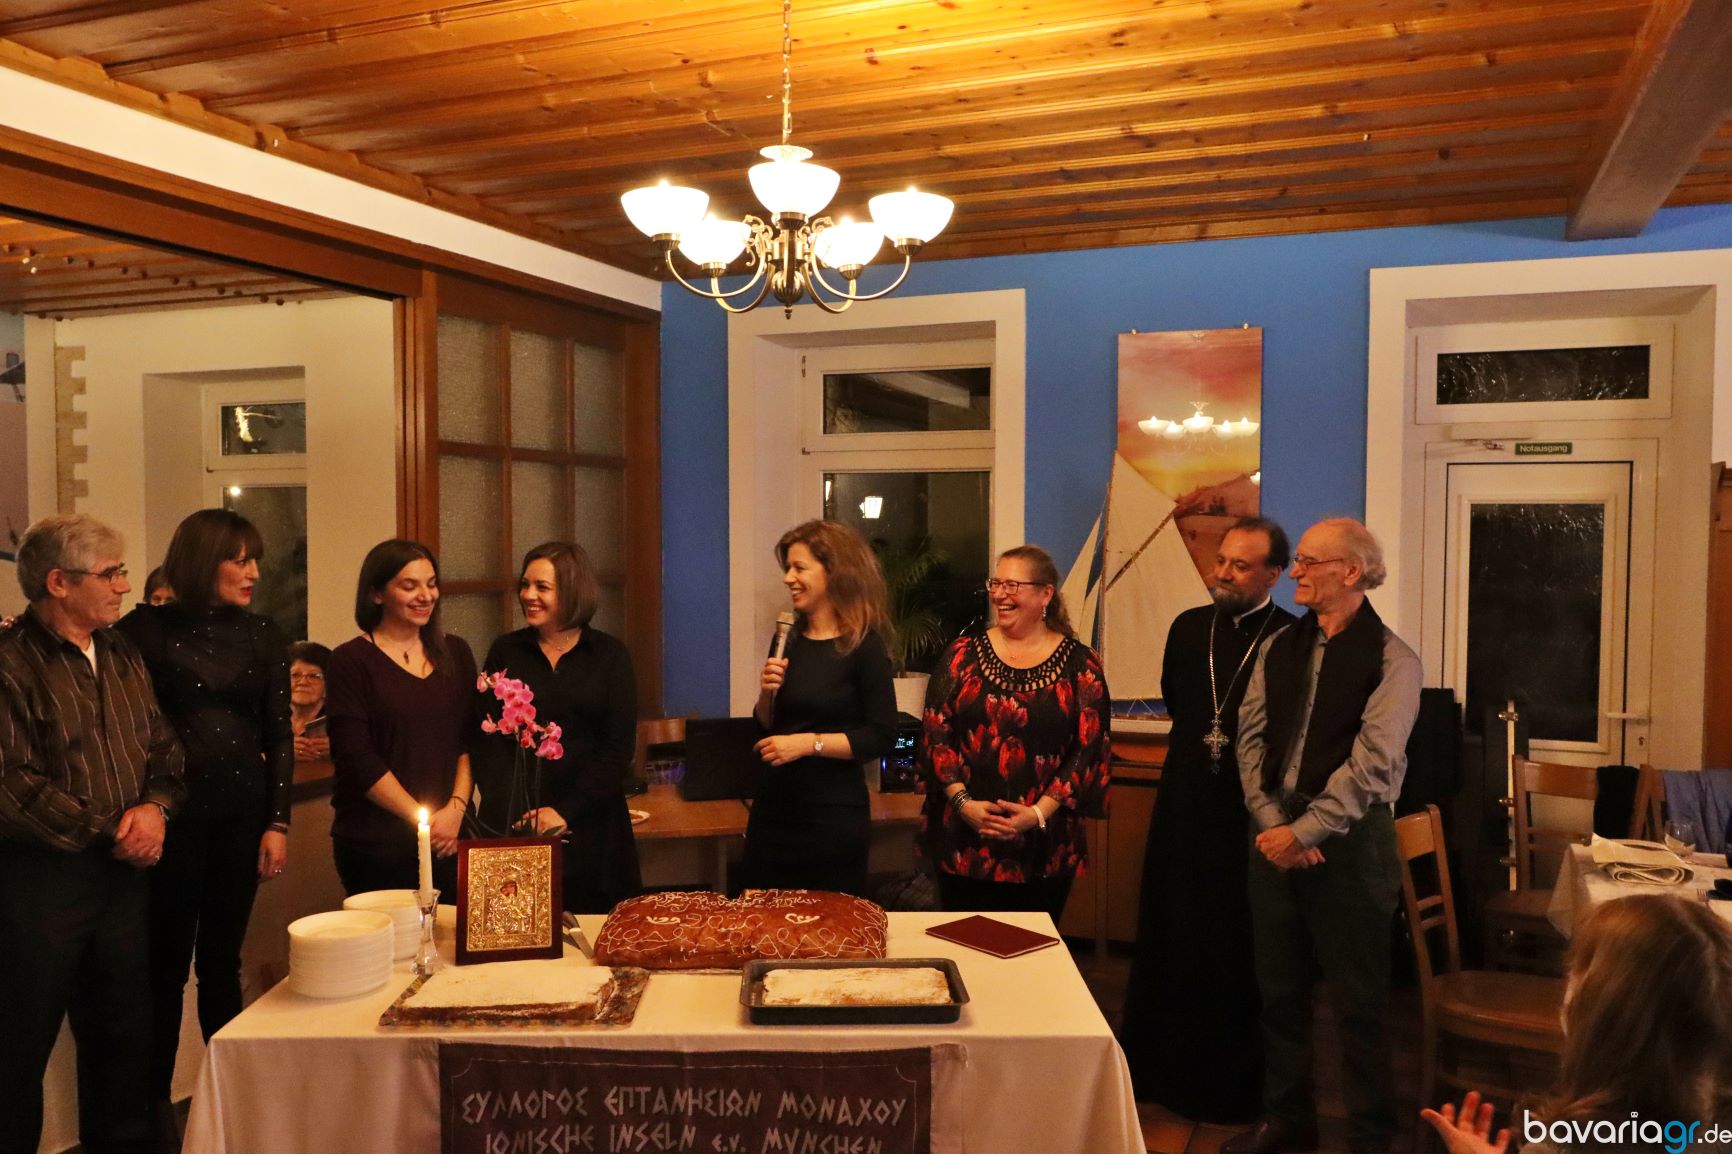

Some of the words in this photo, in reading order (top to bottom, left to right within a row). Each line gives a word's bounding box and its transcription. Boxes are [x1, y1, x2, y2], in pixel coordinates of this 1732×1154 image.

[1520, 445, 1568, 453] Notausgang
[486, 1124, 595, 1154] IONISCHE
[609, 1121, 696, 1153] INSELN
